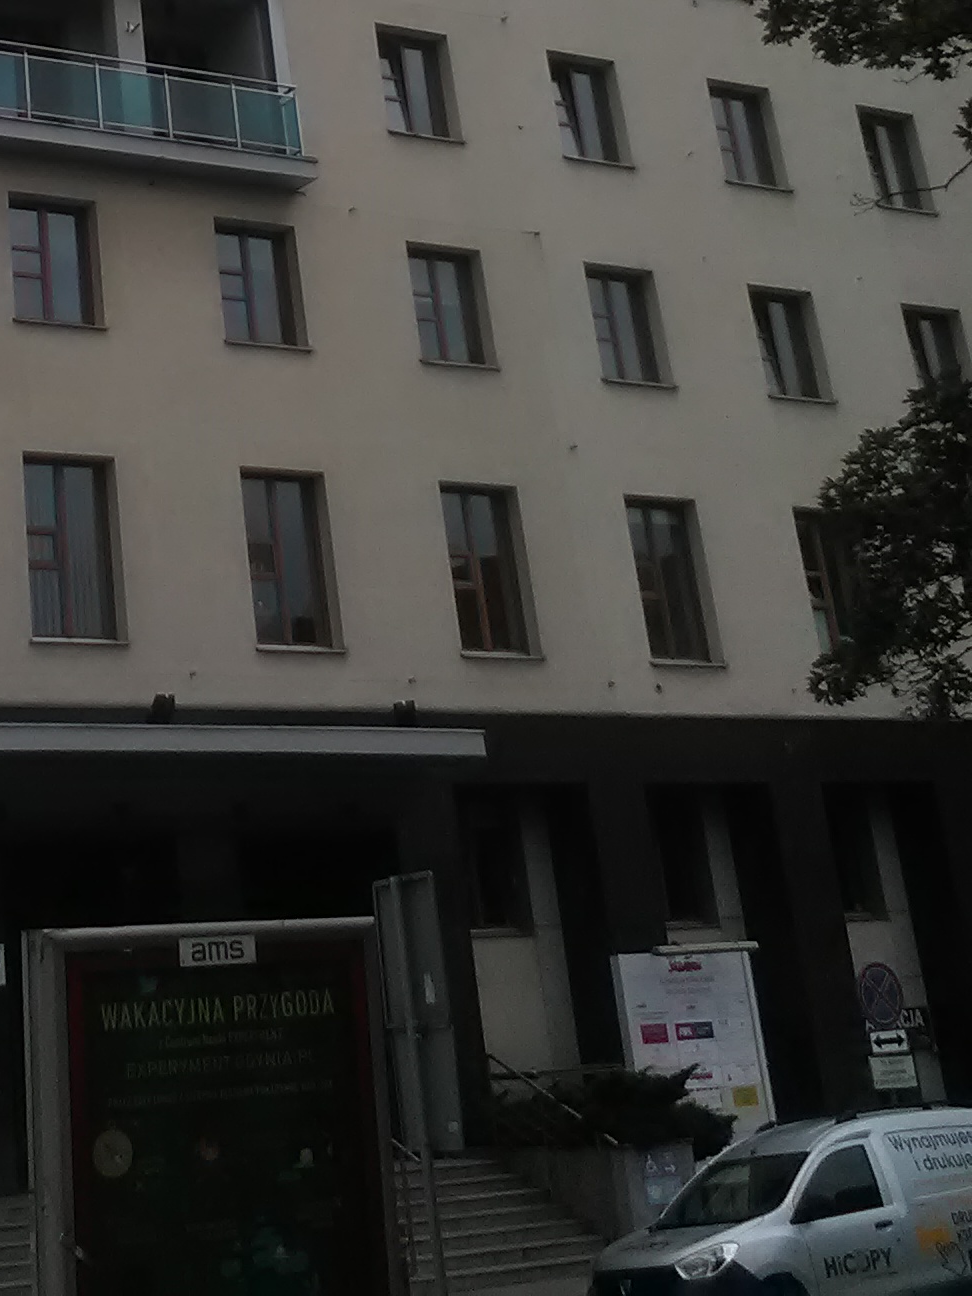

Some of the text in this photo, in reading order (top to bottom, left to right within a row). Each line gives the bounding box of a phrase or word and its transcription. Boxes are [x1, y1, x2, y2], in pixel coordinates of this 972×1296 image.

[191, 938, 245, 963] ams
[101, 987, 335, 1032] WAKACYJNA PRZYGODA
